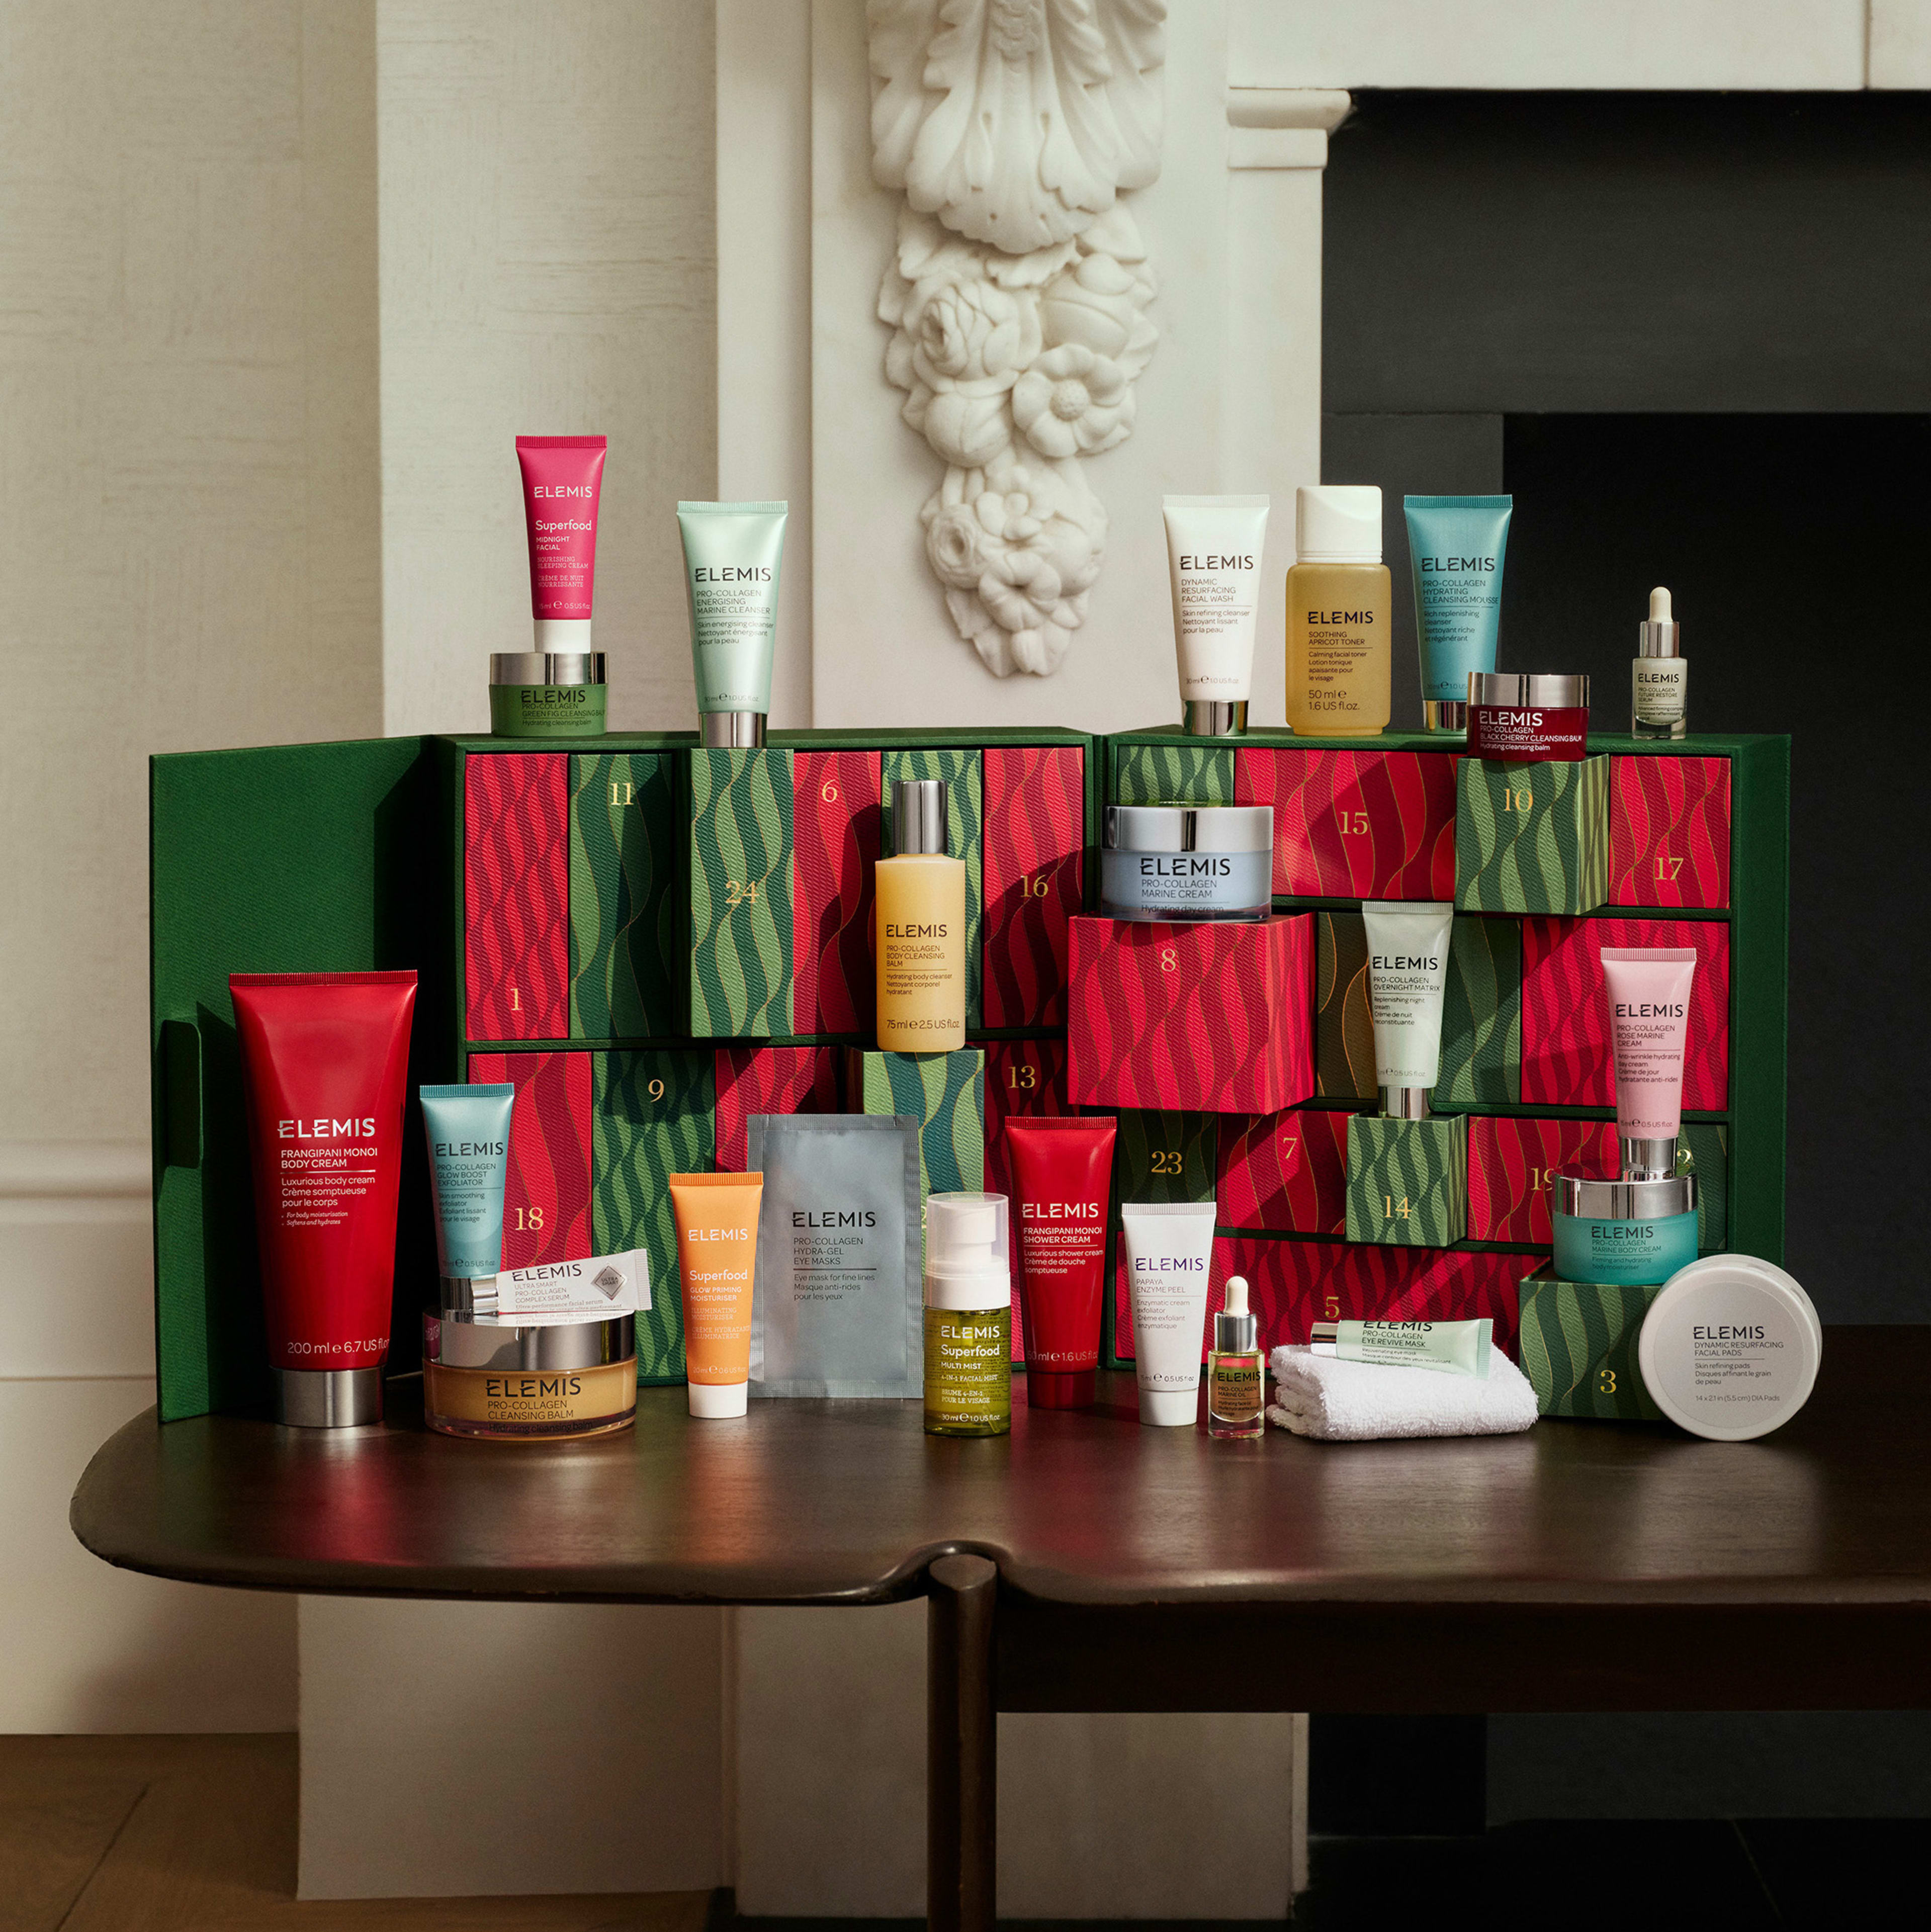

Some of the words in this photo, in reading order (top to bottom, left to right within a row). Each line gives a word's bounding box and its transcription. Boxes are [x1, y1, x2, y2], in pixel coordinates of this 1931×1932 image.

[534, 486, 592, 498] ELEMIS
[536, 519, 592, 533] Superfood
[1180, 556, 1254, 570] ELEMIS
[1421, 558, 1495, 572] ELEMIS
[694, 568, 771, 582] ELEMIS
[1308, 611, 1373, 624] ELEMIS
[1638, 673, 1679, 683] ELEMIS
[521, 690, 585, 702] ELEMIS
[1309, 690, 1322, 698] 50
[1324, 690, 1336, 698] ml
[1309, 702, 1321, 710] 1.6
[1323, 702, 1337, 710] US
[1479, 711, 1543, 726] ELEMIS
[610, 783, 634, 806] 11
[822, 779, 837, 803] 6
[1503, 788, 1533, 812] 10
[1340, 812, 1368, 835] 15
[1139, 858, 1231, 876] ELEMIS
[1655, 857, 1684, 880] 17
[1020, 875, 1048, 898] 16
[1142, 879, 1217, 888] PRO-COLLAGEN
[725, 881, 760, 904] 24
[1142, 890, 1176, 898] MARINE
[1178, 890, 1212, 898] CREAM
[1142, 905, 1180, 914] Hydrating
[1181, 905, 1199, 914] day
[886, 924, 947, 937] ELEMIS
[1161, 949, 1176, 972] 8
[1372, 956, 1438, 970] ELEMIS
[510, 988, 522, 1011] 1
[1616, 1004, 1683, 1018] ELEMIS
[1008, 1066, 1035, 1088] 13
[648, 1079, 664, 1103] 9
[277, 1118, 376, 1138] ELEMIS
[282, 1150, 342, 1158] FRANGIPANI
[344, 1148, 378, 1157] MONOI
[435, 1142, 503, 1157] ELEMIS
[1283, 1137, 1297, 1159] 7
[282, 1161, 310, 1169] BODY
[311, 1160, 346, 1168] CREAM
[1151, 1151, 1182, 1174] 23
[282, 1178, 323, 1186] Luxurious
[325, 1177, 347, 1187] body
[282, 1188, 311, 1196] Crème
[313, 1188, 367, 1198] somptueuse
[283, 1200, 302, 1208] pour
[1022, 1203, 1099, 1218] ELEMIS
[1384, 1195, 1412, 1219] 14
[514, 1207, 544, 1231] 18
[791, 1212, 876, 1227] ELEMIS
[688, 1228, 748, 1241] ELEMIS
[1591, 1226, 1653, 1239] ELEMIS
[1135, 1258, 1203, 1271] ELEMIS
[512, 1264, 582, 1281] ELEMIS
[689, 1269, 747, 1283] Superfood
[795, 1274, 808, 1282] Eye
[515, 1288, 567, 1297] PRO-COLLAGEN
[515, 1295, 548, 1303] COMPLEX
[1325, 1296, 1339, 1318] 5
[941, 1326, 1000, 1339] ELEMIS
[1363, 1321, 1433, 1332] ELEMIS
[1693, 1326, 1765, 1339] ELEMIS
[1362, 1330, 1423, 1340] PRO-COLLAGEN
[1377, 1338, 1404, 1346] REVIVE
[941, 1344, 1000, 1359] Superfood
[1217, 1371, 1261, 1382] ELEMIS
[1600, 1370, 1616, 1393] 3
[485, 1377, 581, 1397] ELEMIS
[488, 1400, 567, 1410] PRO-COLLAGEN
[488, 1411, 545, 1420] CLEANSING
[548, 1410, 573, 1419] BALM
